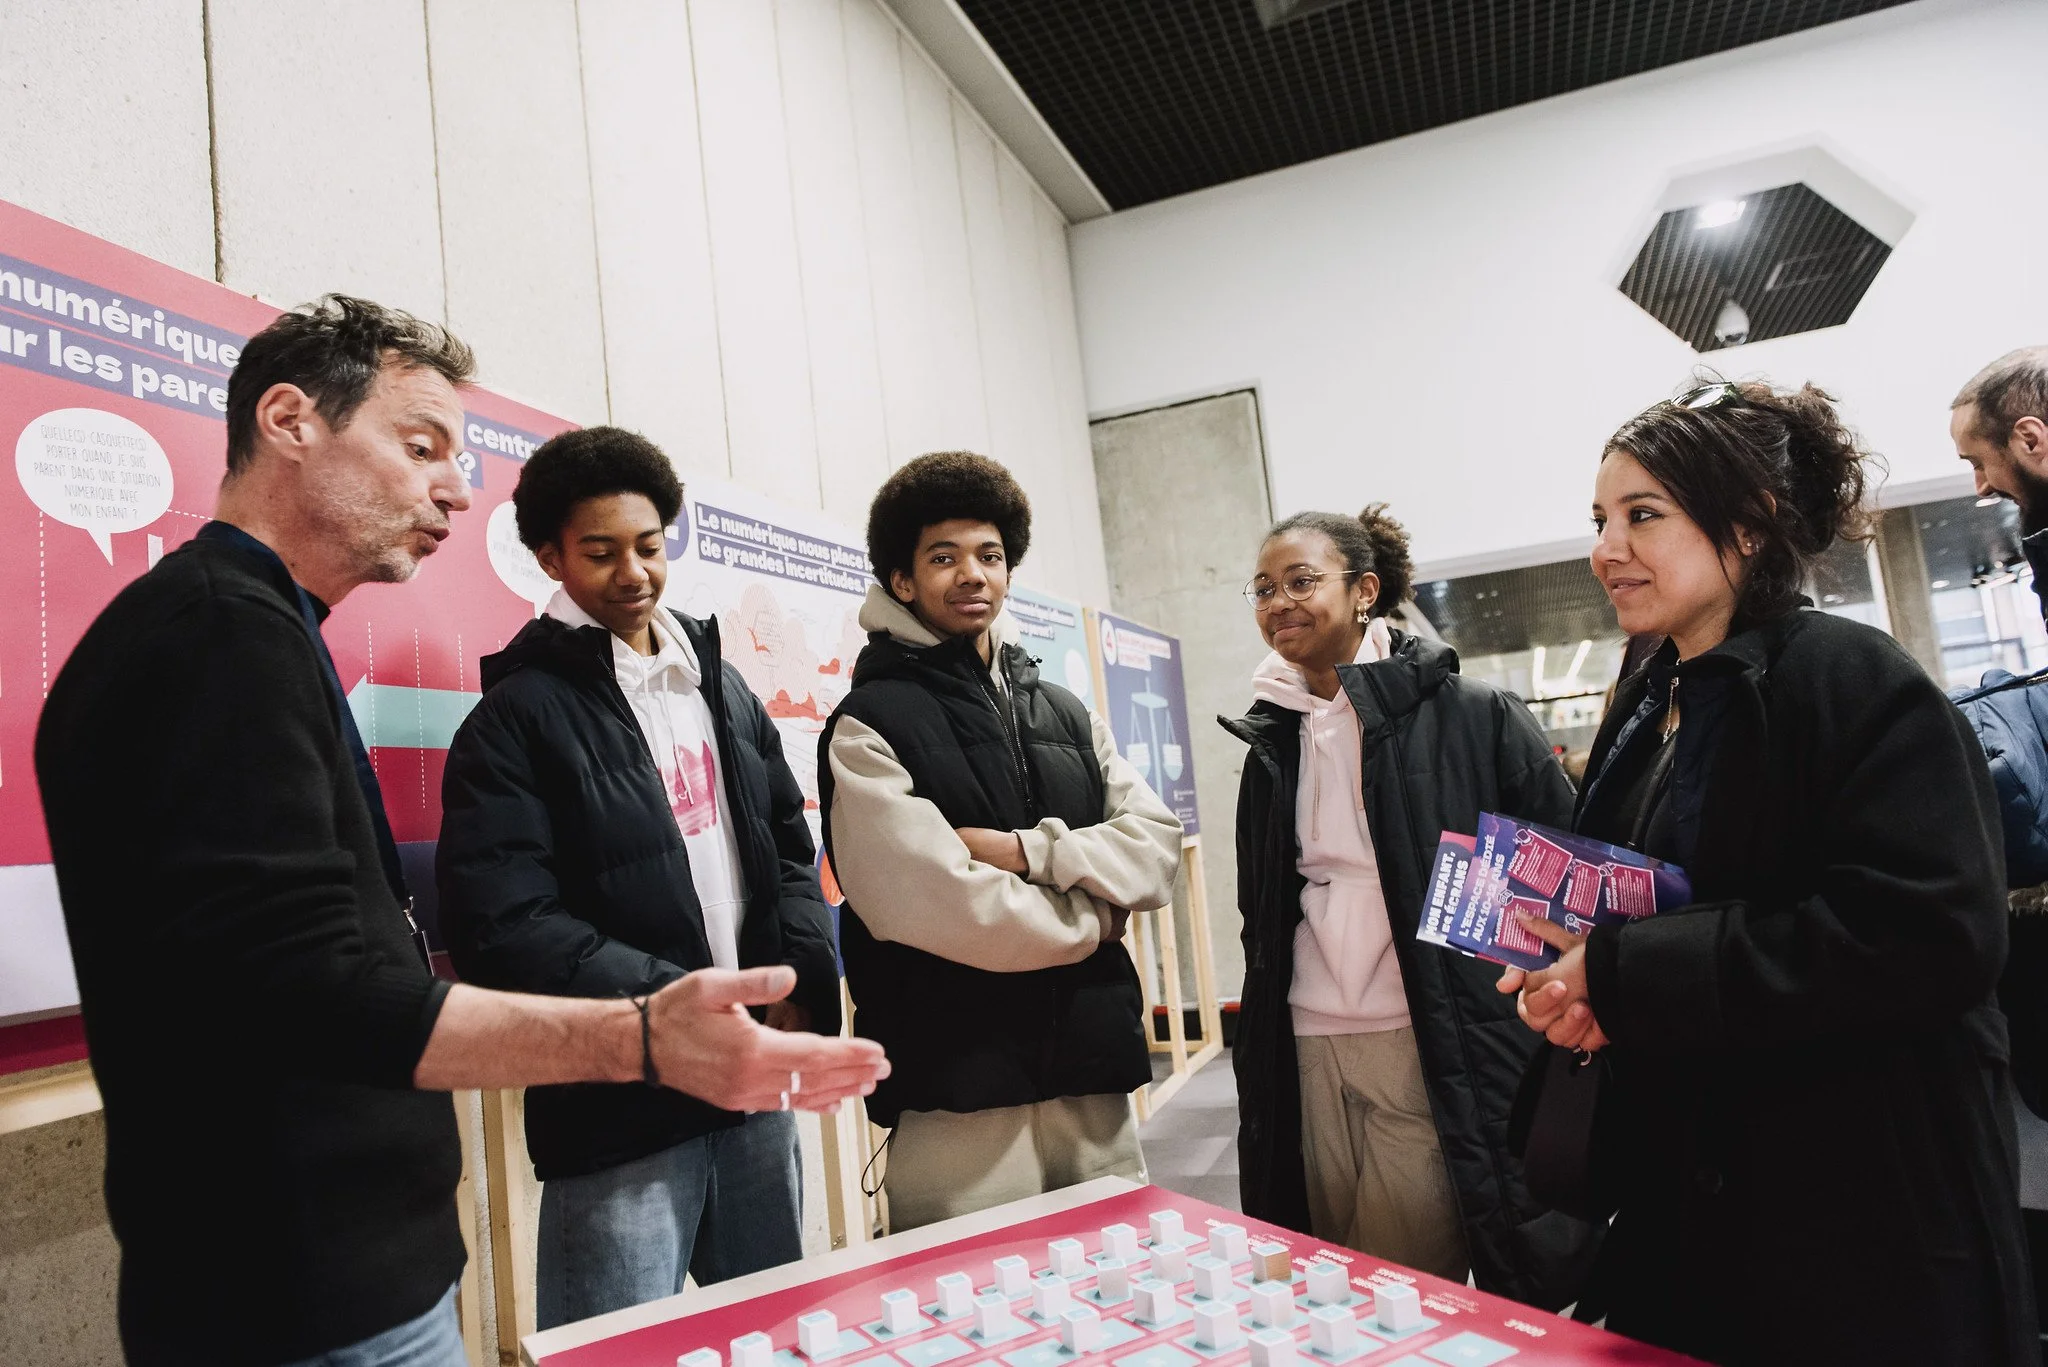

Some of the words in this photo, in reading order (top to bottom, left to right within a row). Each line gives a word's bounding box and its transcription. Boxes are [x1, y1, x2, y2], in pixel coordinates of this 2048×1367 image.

[0, 269, 242, 369] numérique
[49, 328, 123, 383] les
[46, 444, 77, 461] PORTER
[82, 449, 112, 465] QUAND
[117, 454, 127, 467] JE
[130, 454, 147, 469] SUIS
[467, 423, 541, 460] centr
[34, 462, 66, 479] PARENT
[71, 466, 95, 482] DANS
[99, 469, 116, 484] UNE
[120, 471, 161, 488] SITUATION
[119, 489, 139, 503] AVEC
[70, 502, 92, 517] MON
[96, 505, 128, 520] ENFANT
[132, 508, 138, 520] ?
[697, 505, 720, 530] Le
[721, 515, 798, 552] numérique
[798, 538, 831, 562] nous
[830, 545, 864, 570] place
[700, 536, 722, 559] de
[723, 545, 785, 576] grandes
[785, 556, 865, 594] incertitudes.
[1432, 851, 1456, 907] ENFANT,
[1508, 850, 1520, 871] HOCUS
[1512, 854, 1526, 875] FOCUS
[1443, 860, 1469, 915] ÉCRANS
[1459, 877, 1485, 938] L'ESPACE
[1478, 834, 1496, 878] DÉDIÉ
[1472, 915, 1488, 942] AUX
[1491, 853, 1505, 881] ANS
[1425, 906, 1441, 937] MON
